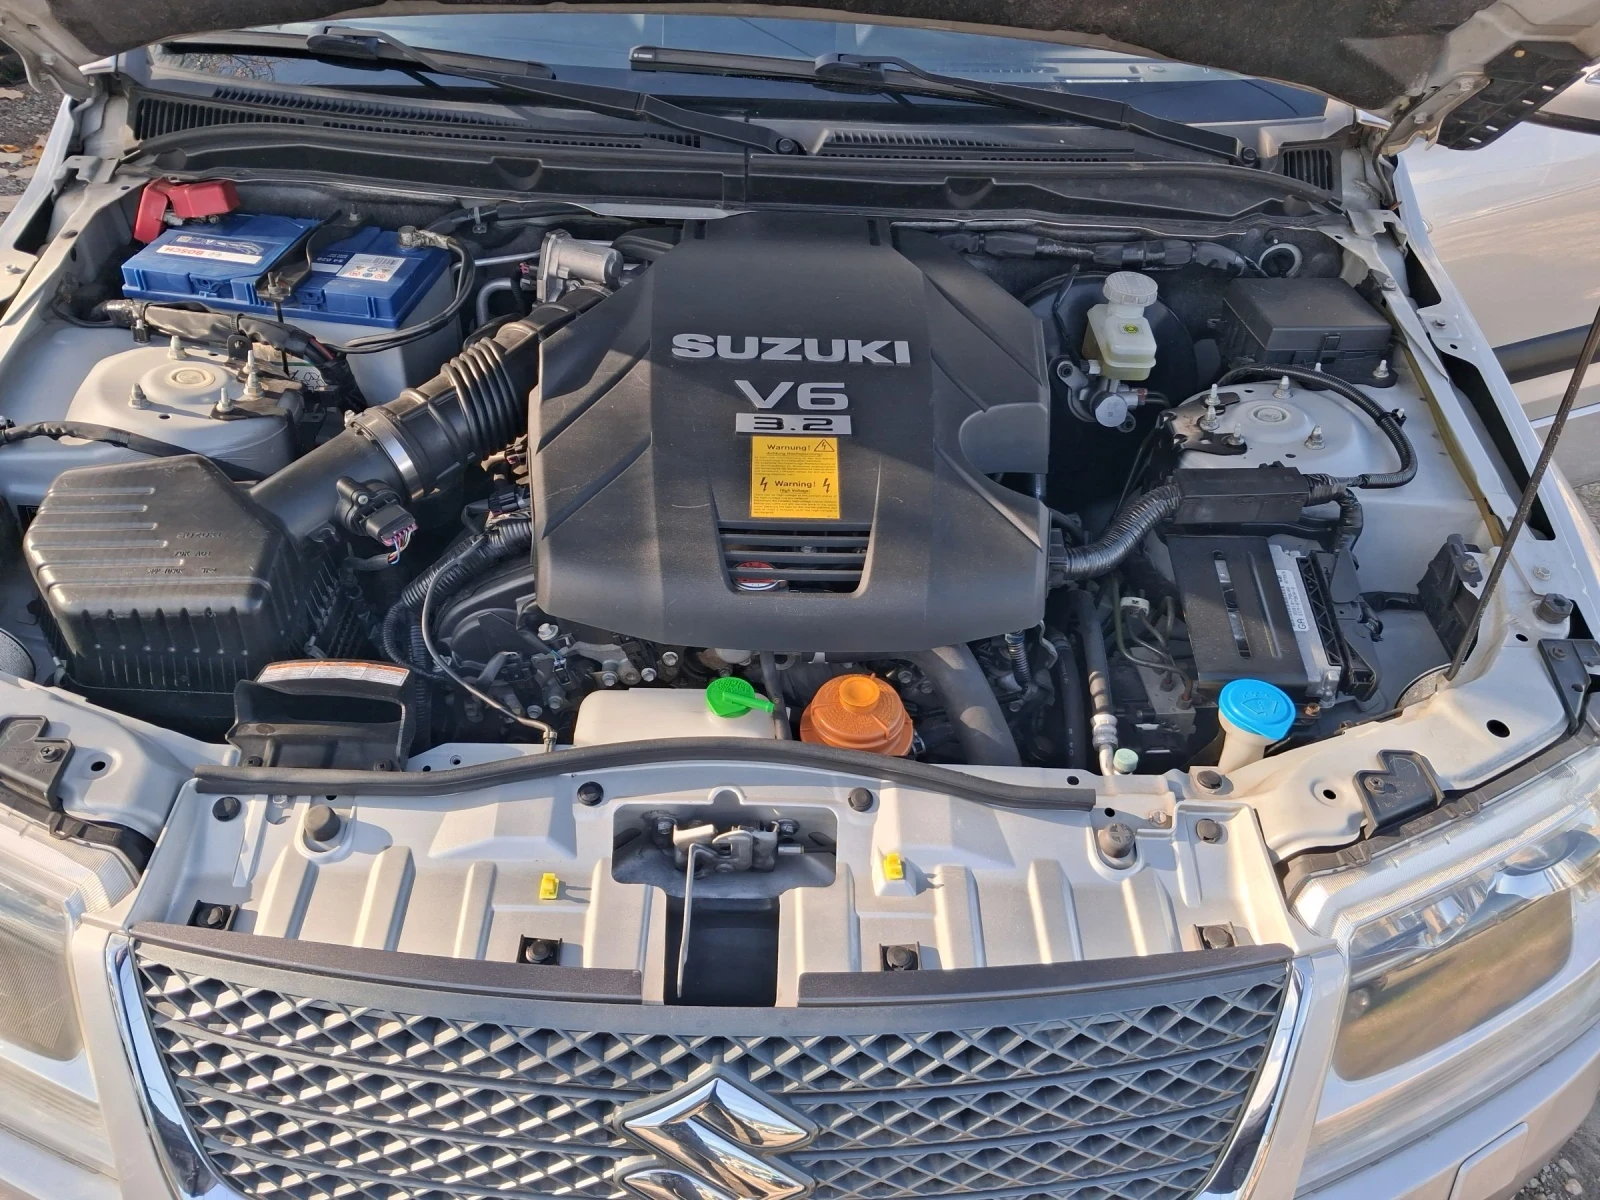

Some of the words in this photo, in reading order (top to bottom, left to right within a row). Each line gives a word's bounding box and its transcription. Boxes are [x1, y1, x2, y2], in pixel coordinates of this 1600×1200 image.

[164, 246, 205, 256] BOSCH
[671, 333, 911, 366] SUZUKI
[734, 379, 849, 411] V6
[753, 415, 834, 432] 3.2
